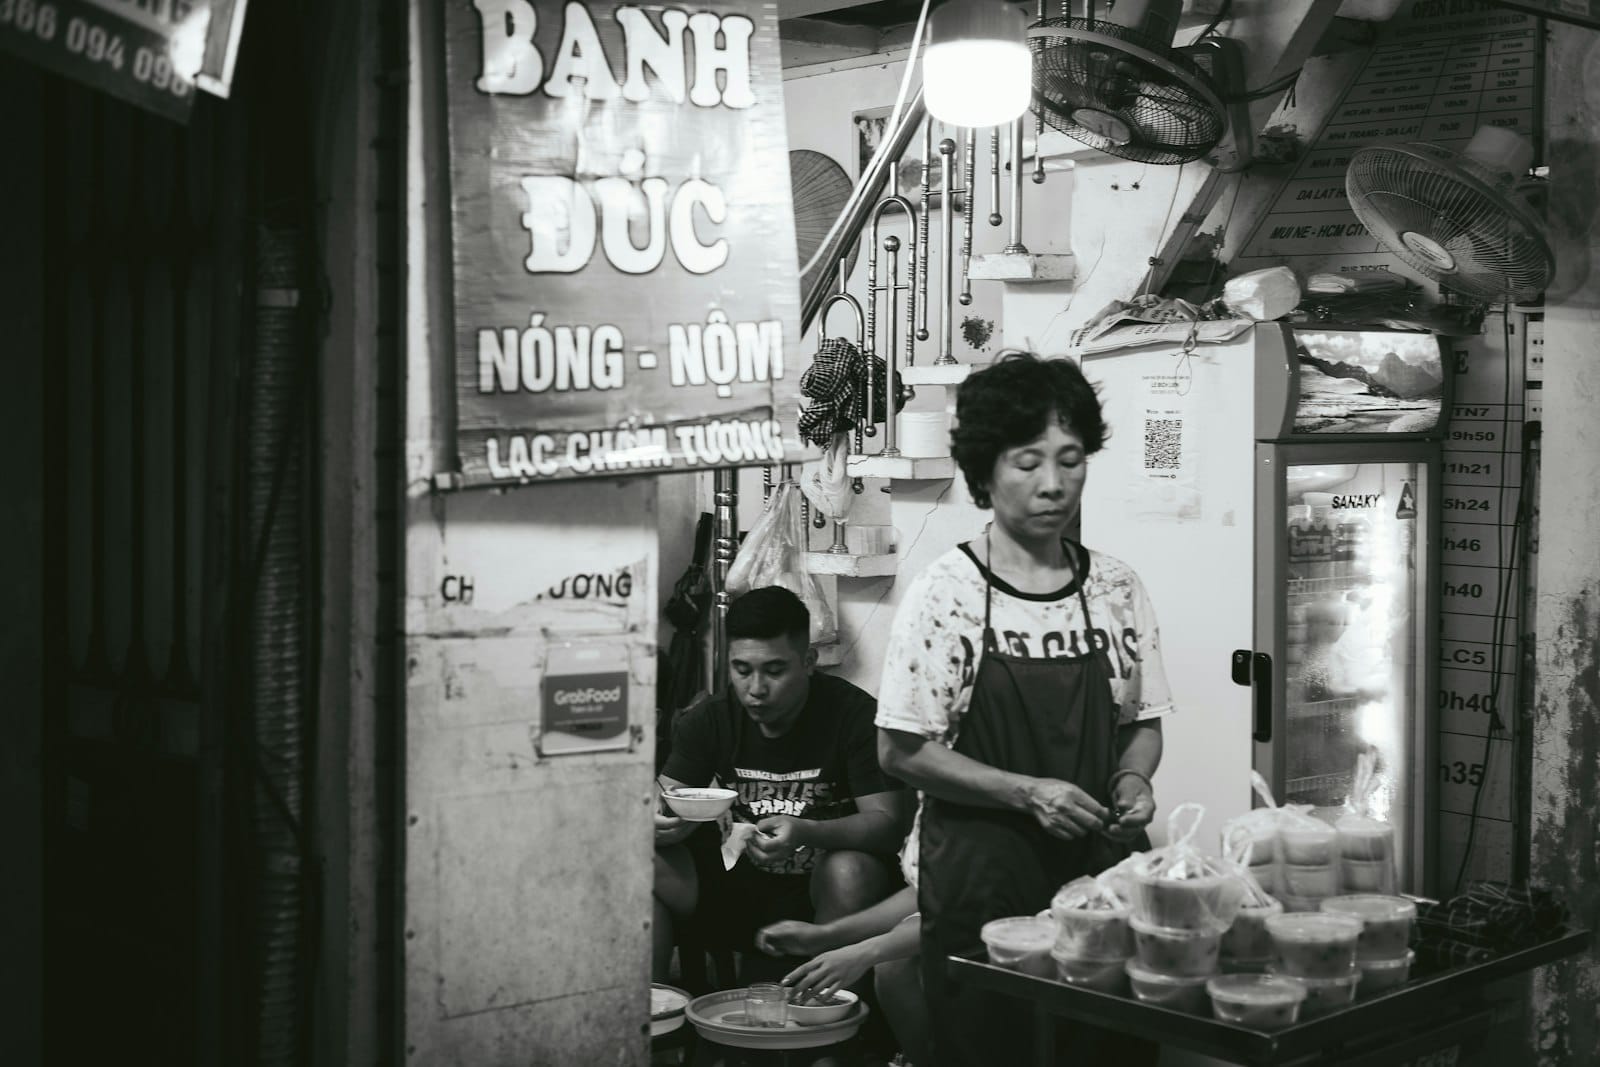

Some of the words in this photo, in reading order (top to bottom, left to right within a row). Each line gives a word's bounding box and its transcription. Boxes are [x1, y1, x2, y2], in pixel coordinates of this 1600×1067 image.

[65, 16, 126, 70] 094
[1316, 223, 1346, 238] HCM
[477, 311, 626, 394] NÓNG
[638, 351, 658, 370] -
[667, 307, 785, 399] NỘM
[485, 434, 560, 484] LẠC
[1331, 493, 1381, 510] SANAKY
[553, 686, 622, 706] GrabFood
